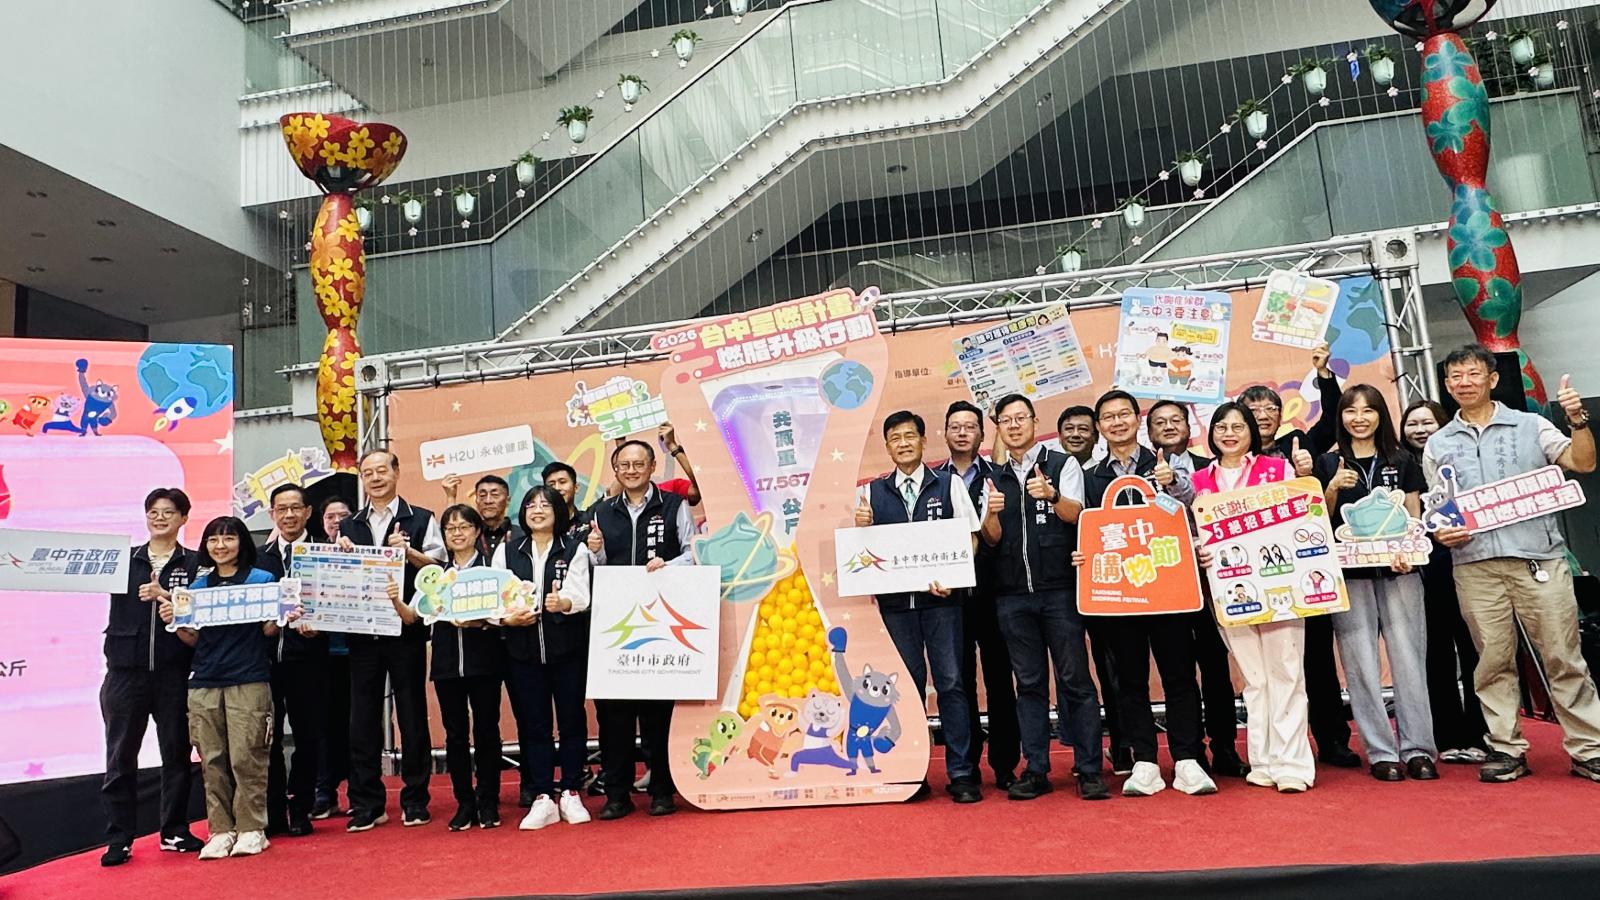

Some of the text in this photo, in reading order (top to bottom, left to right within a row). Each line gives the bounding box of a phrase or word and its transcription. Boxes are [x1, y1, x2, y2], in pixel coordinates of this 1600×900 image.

[1154, 295, 1205, 305] 代謝症候群
[699, 293, 854, 349] 台中星燃計畫
[658, 329, 697, 349] 2026
[716, 313, 875, 370] 燃脂升級行動
[772, 410, 797, 467] 共減重
[449, 449, 475, 463] H2U
[756, 473, 810, 492] 17,567
[1213, 487, 1288, 519] 代謝症候群
[1212, 498, 1309, 540] 5絕招要做到
[1099, 518, 1154, 551] 臺中
[30, 548, 121, 561] 臺中市政府
[892, 550, 969, 565] 臺中市政府衛生局
[1092, 536, 1182, 588] 購物節
[64, 562, 118, 575] 運動局
[617, 653, 690, 666] 臺中市政府
